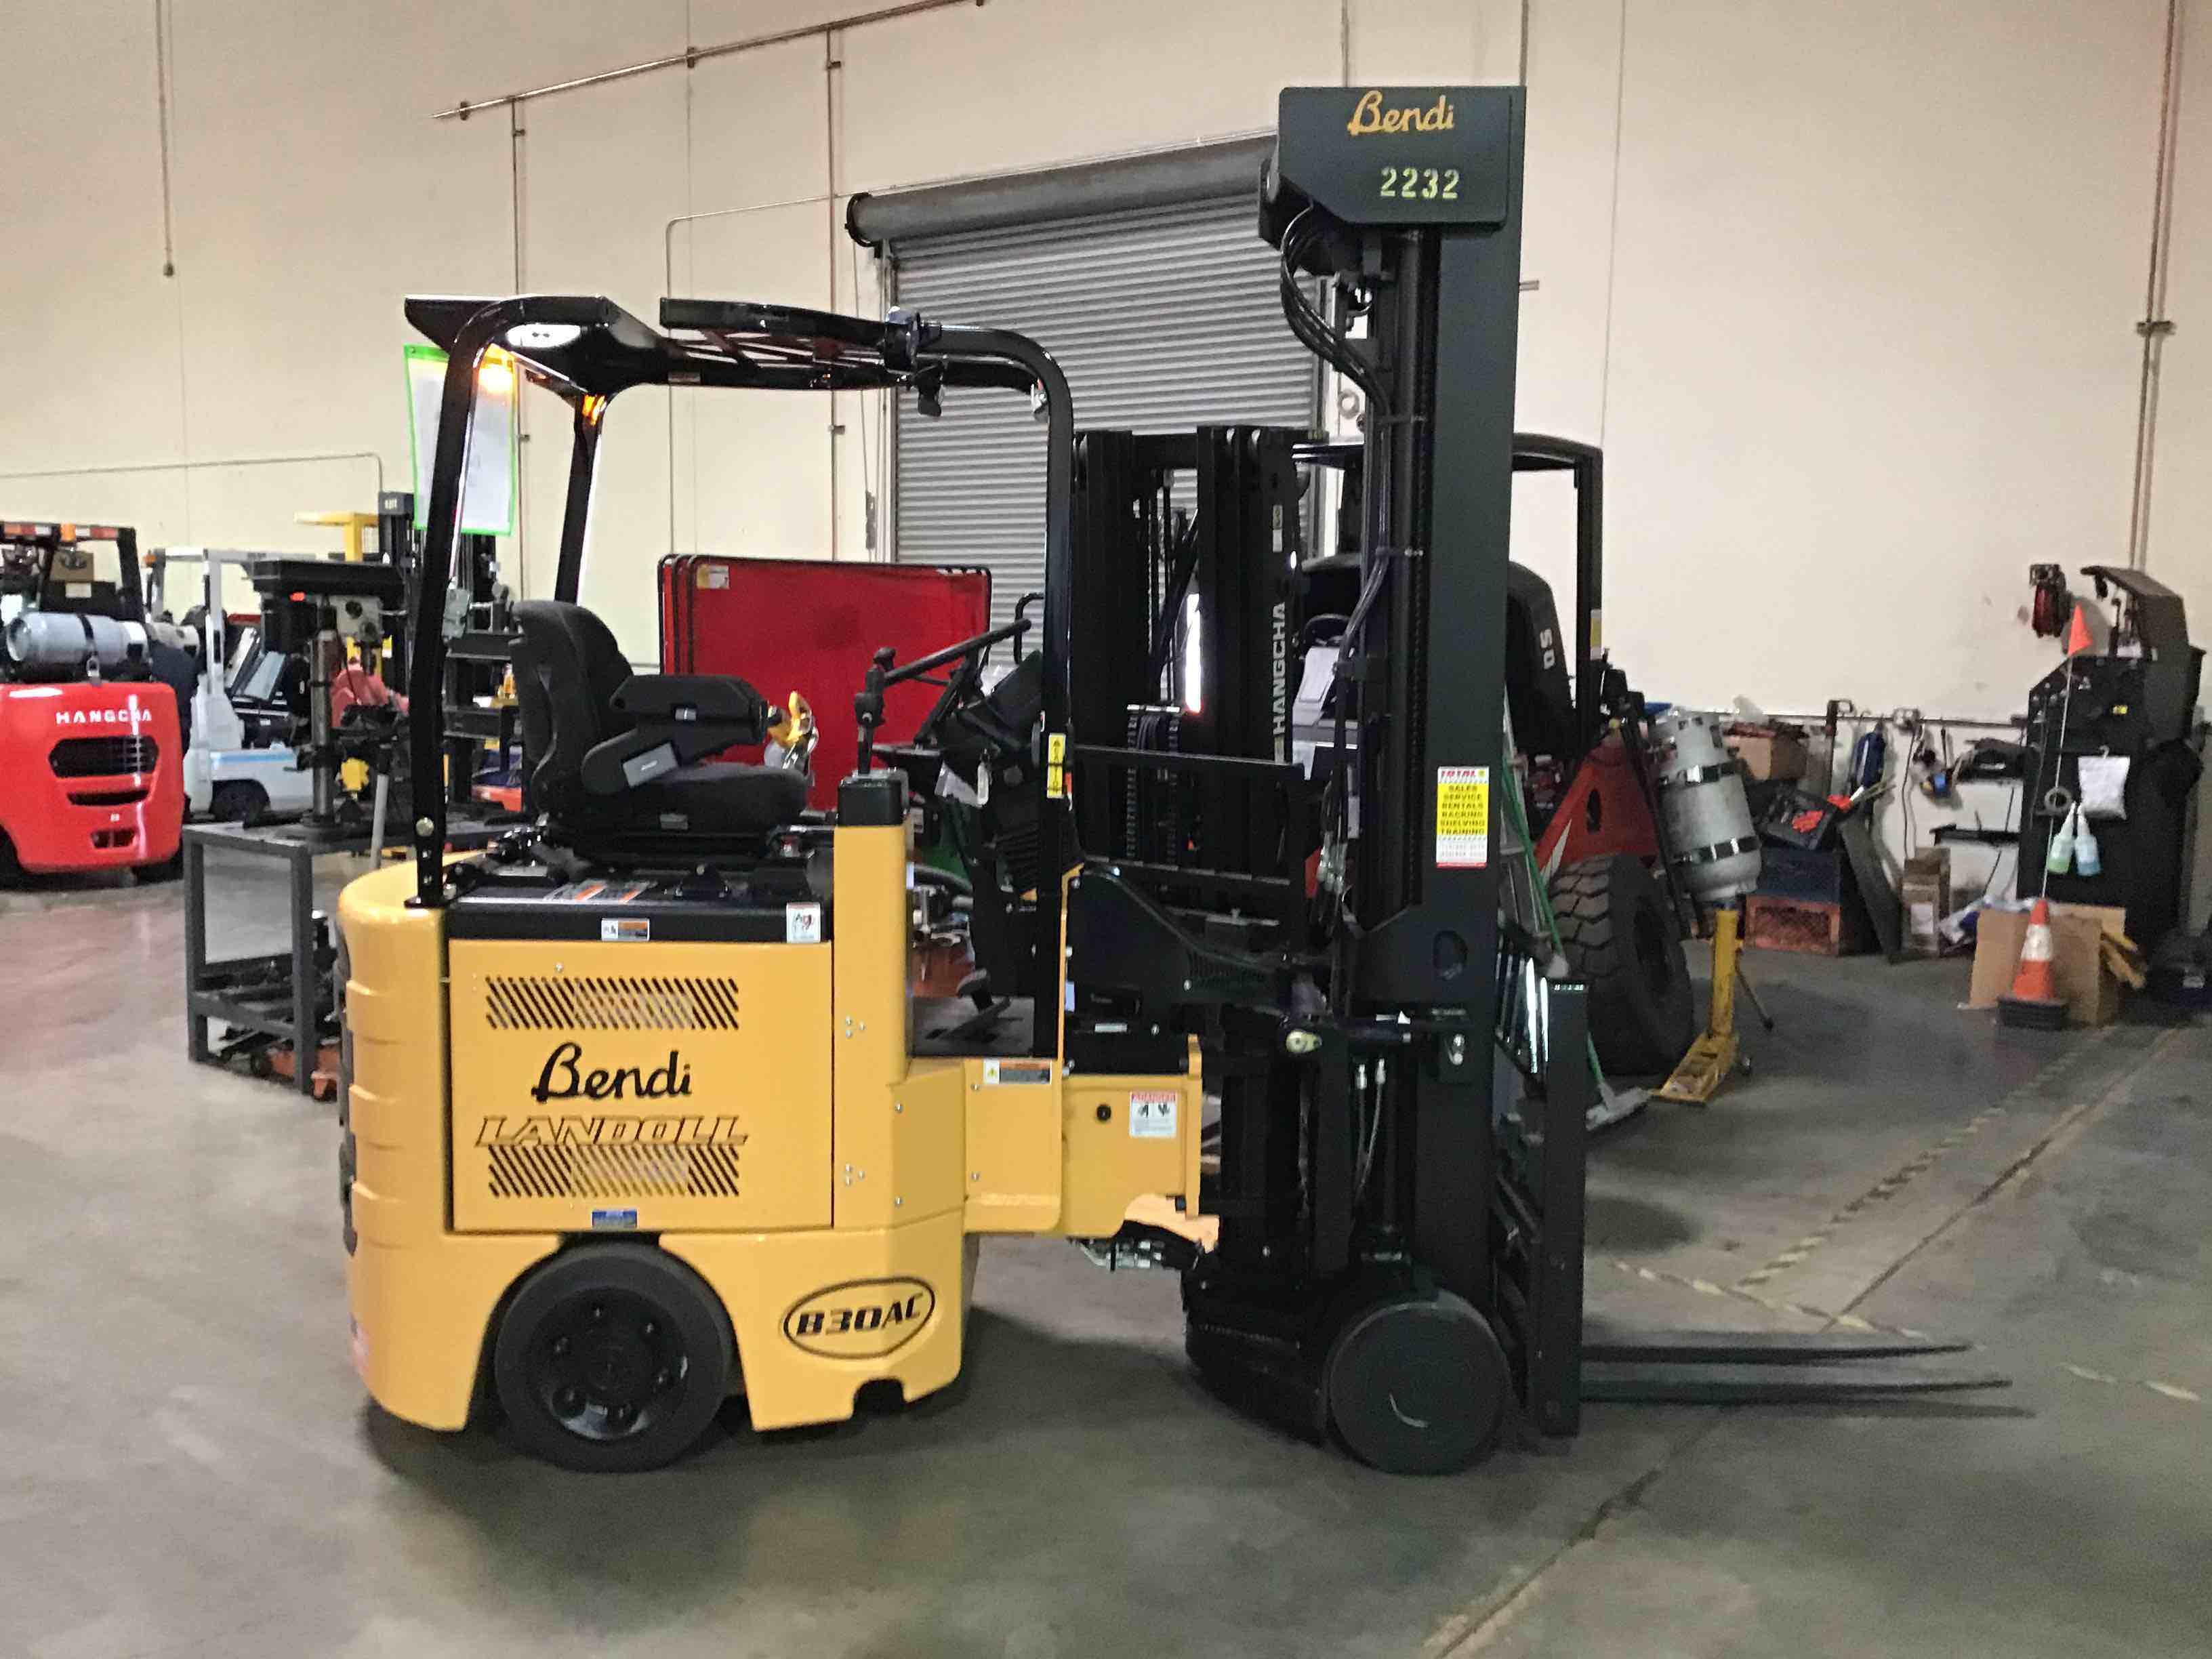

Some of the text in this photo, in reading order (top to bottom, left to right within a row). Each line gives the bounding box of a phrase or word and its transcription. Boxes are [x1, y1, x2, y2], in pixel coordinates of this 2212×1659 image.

[1347, 89, 1455, 136] Bendi
[1380, 167, 1460, 199] 2232
[1273, 601, 1286, 735] HANGCHA
[531, 1041, 692, 1103] Bendi
[474, 1115, 748, 1147] LANDOLL
